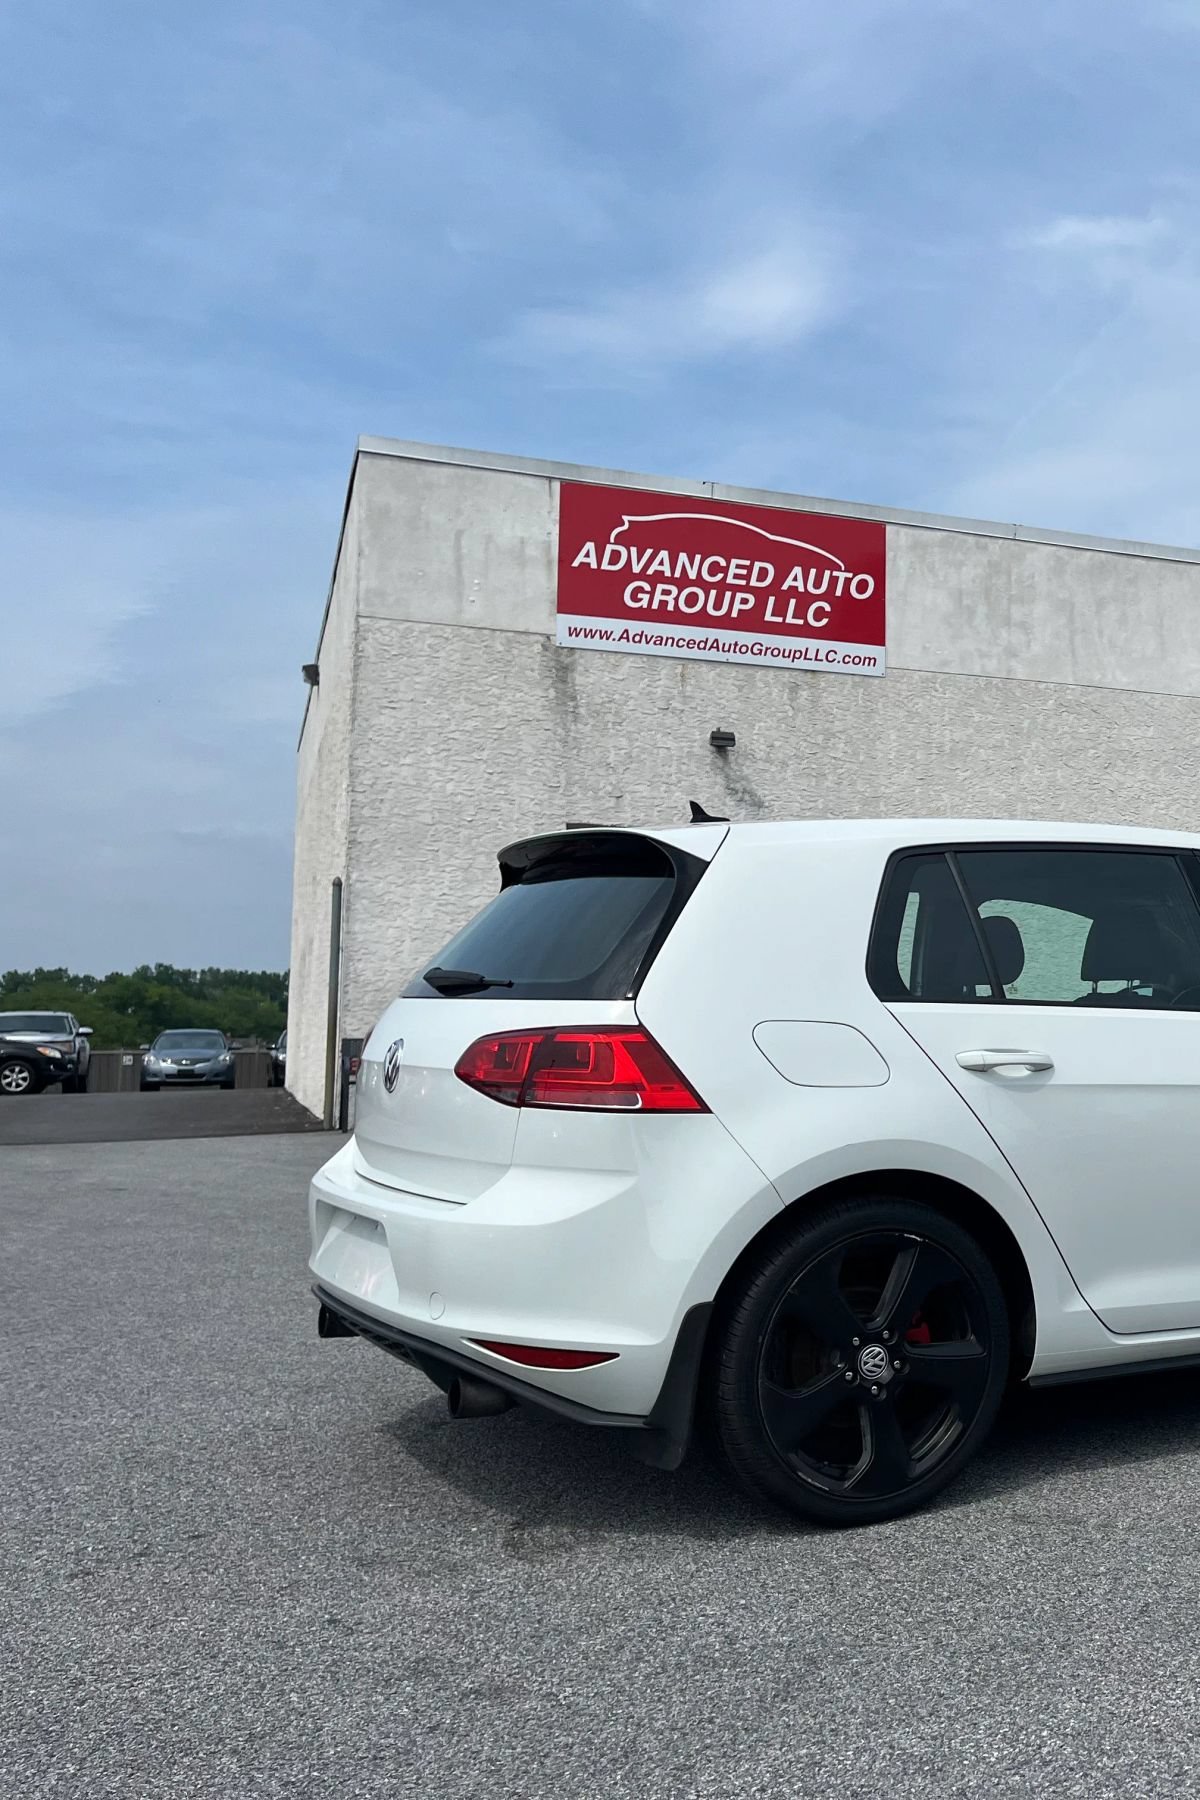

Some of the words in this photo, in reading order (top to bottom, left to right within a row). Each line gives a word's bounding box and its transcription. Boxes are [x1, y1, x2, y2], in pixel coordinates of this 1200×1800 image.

[571, 541, 775, 588] ADVANCED
[781, 566, 875, 600] AUTO
[623, 580, 755, 619] GROUP
[763, 596, 832, 627] LLC
[567, 625, 877, 668] www.AdvancedAutoGroupLLC.com
